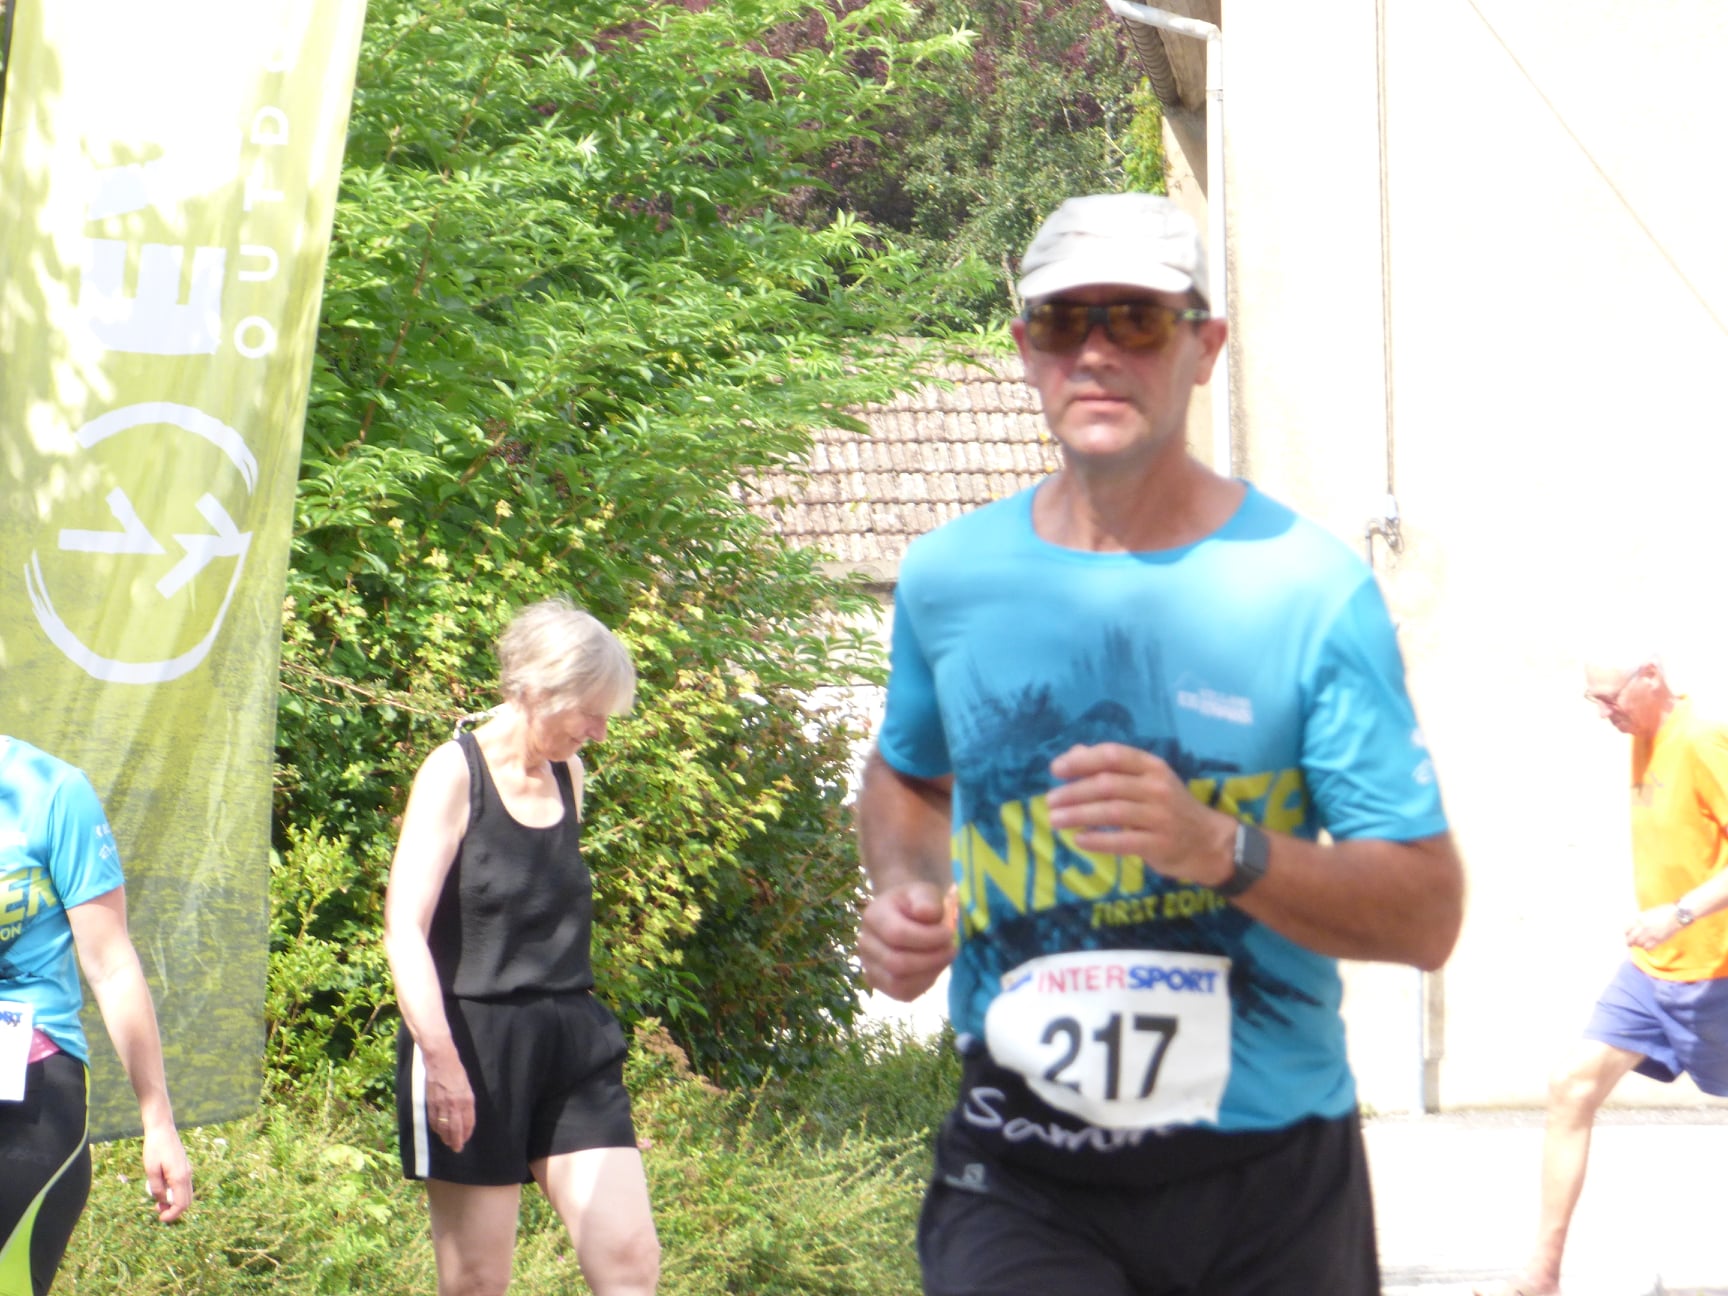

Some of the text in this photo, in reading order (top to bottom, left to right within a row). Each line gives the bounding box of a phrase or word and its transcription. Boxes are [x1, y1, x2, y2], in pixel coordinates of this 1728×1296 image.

[1089, 896, 1158, 930] FIRST
[1037, 964, 1219, 994] INTERSPORT
[1040, 1012, 1178, 1101] 217
